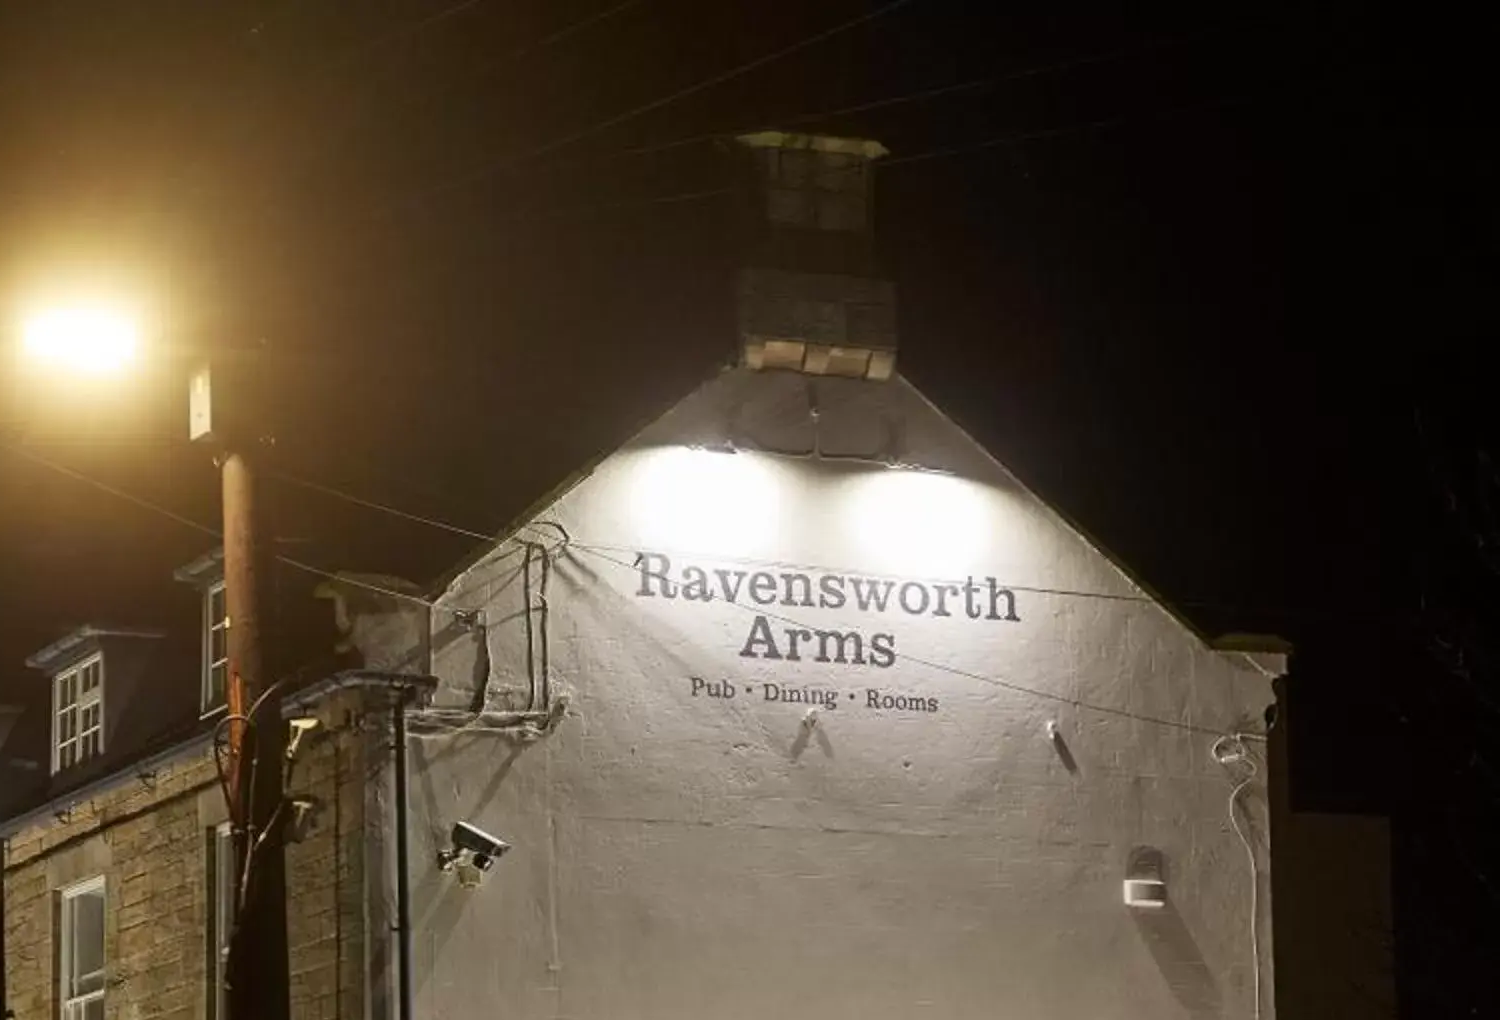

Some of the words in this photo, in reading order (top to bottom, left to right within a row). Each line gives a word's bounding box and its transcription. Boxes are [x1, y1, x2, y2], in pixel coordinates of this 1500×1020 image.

[635, 551, 1021, 622] Ravensworth
[739, 615, 897, 668] Arms
[690, 677, 736, 700] Pub
[763, 682, 838, 710] Dining
[866, 688, 939, 713] Rooms
